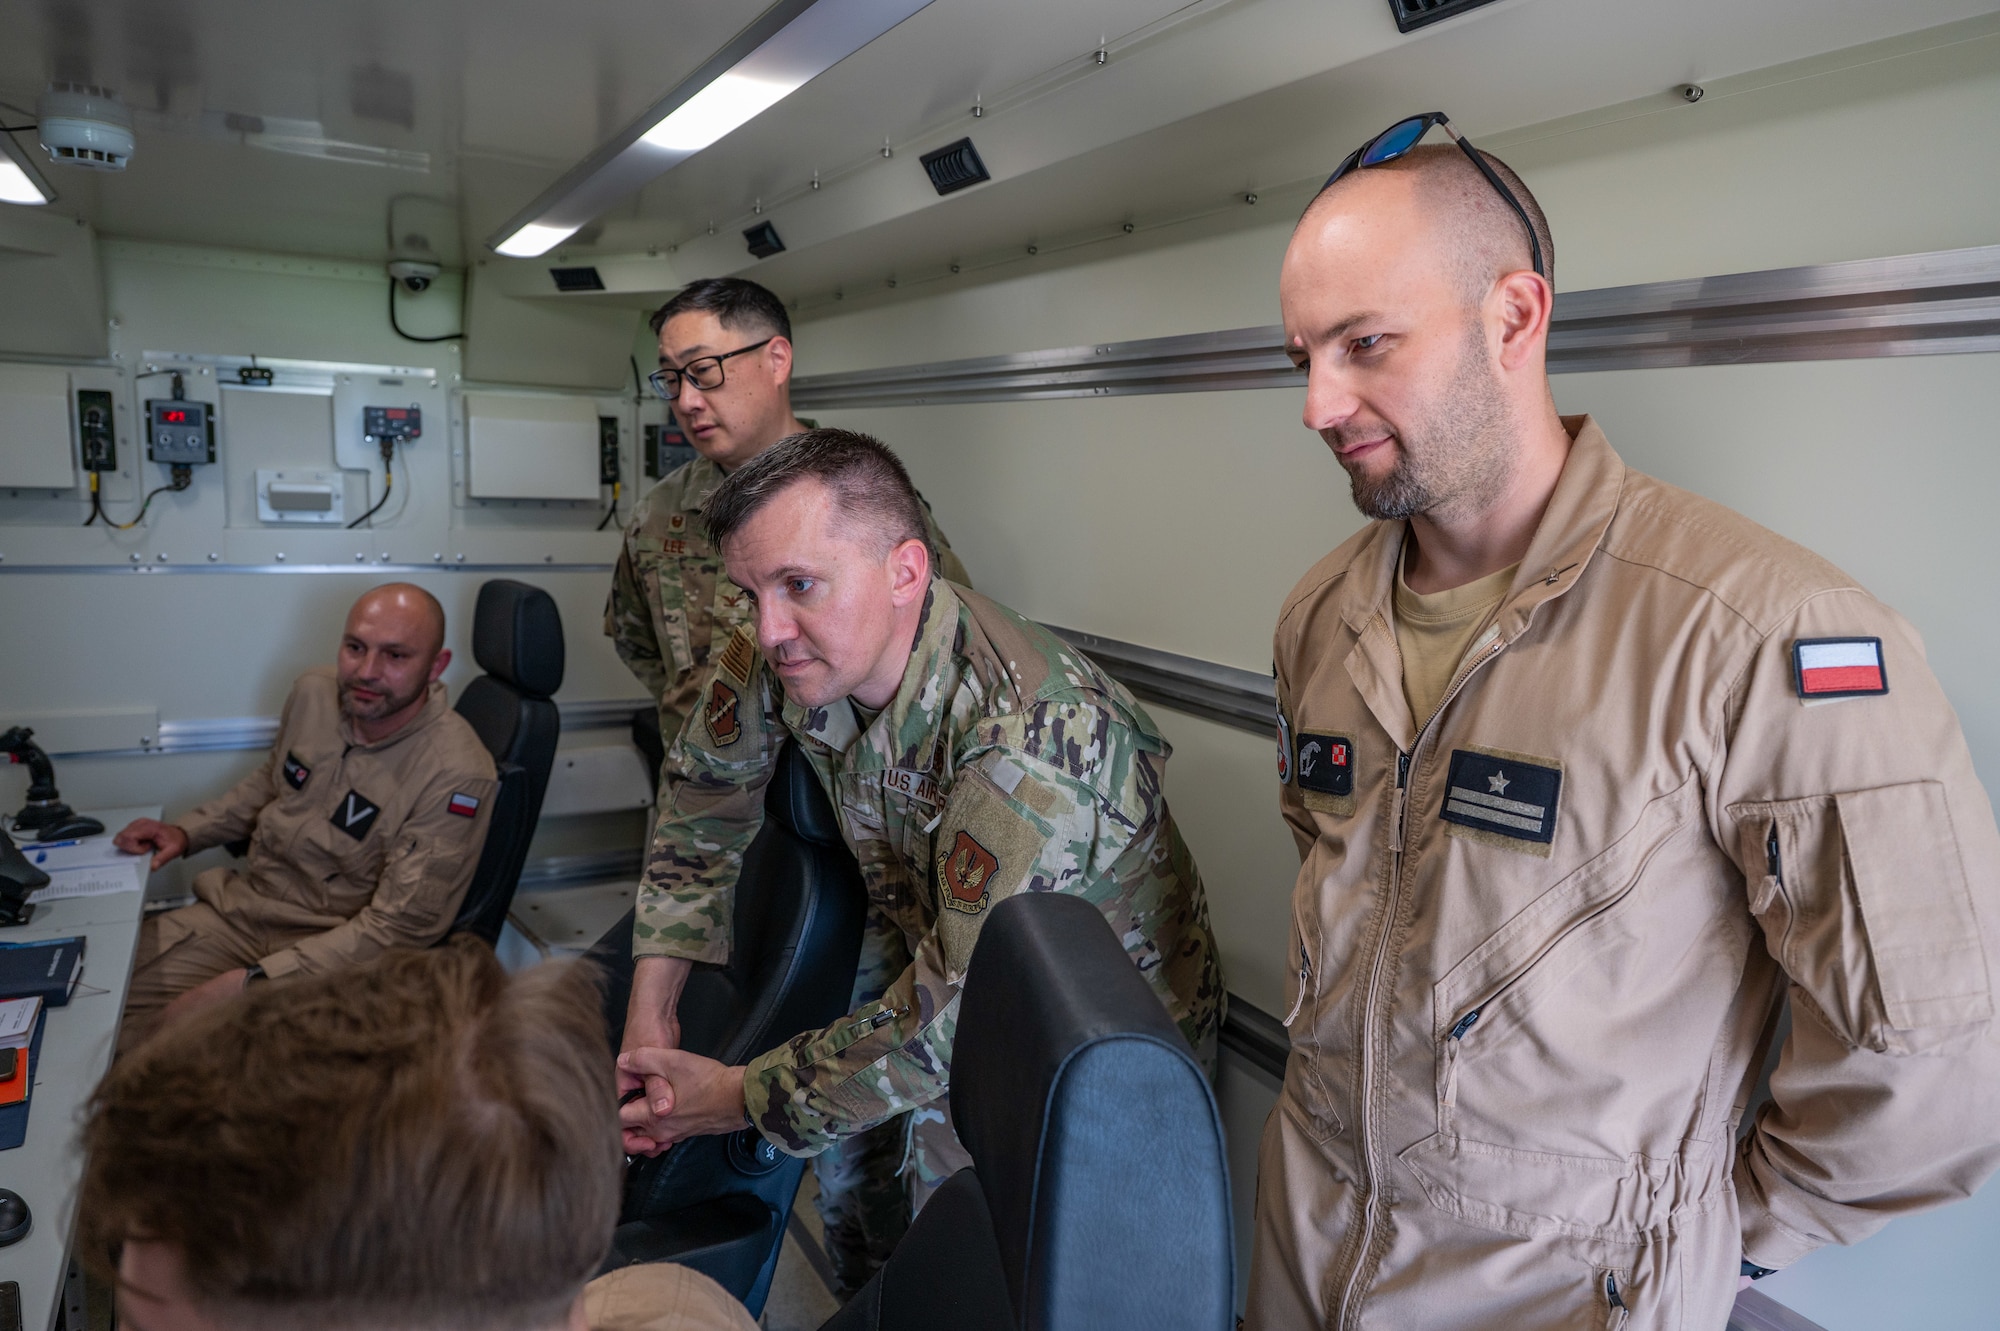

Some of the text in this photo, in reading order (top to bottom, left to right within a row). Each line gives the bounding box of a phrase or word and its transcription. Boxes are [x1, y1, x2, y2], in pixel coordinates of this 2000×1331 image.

[663, 538, 686, 554] LEE
[887, 769, 938, 803] U.S. AIR
